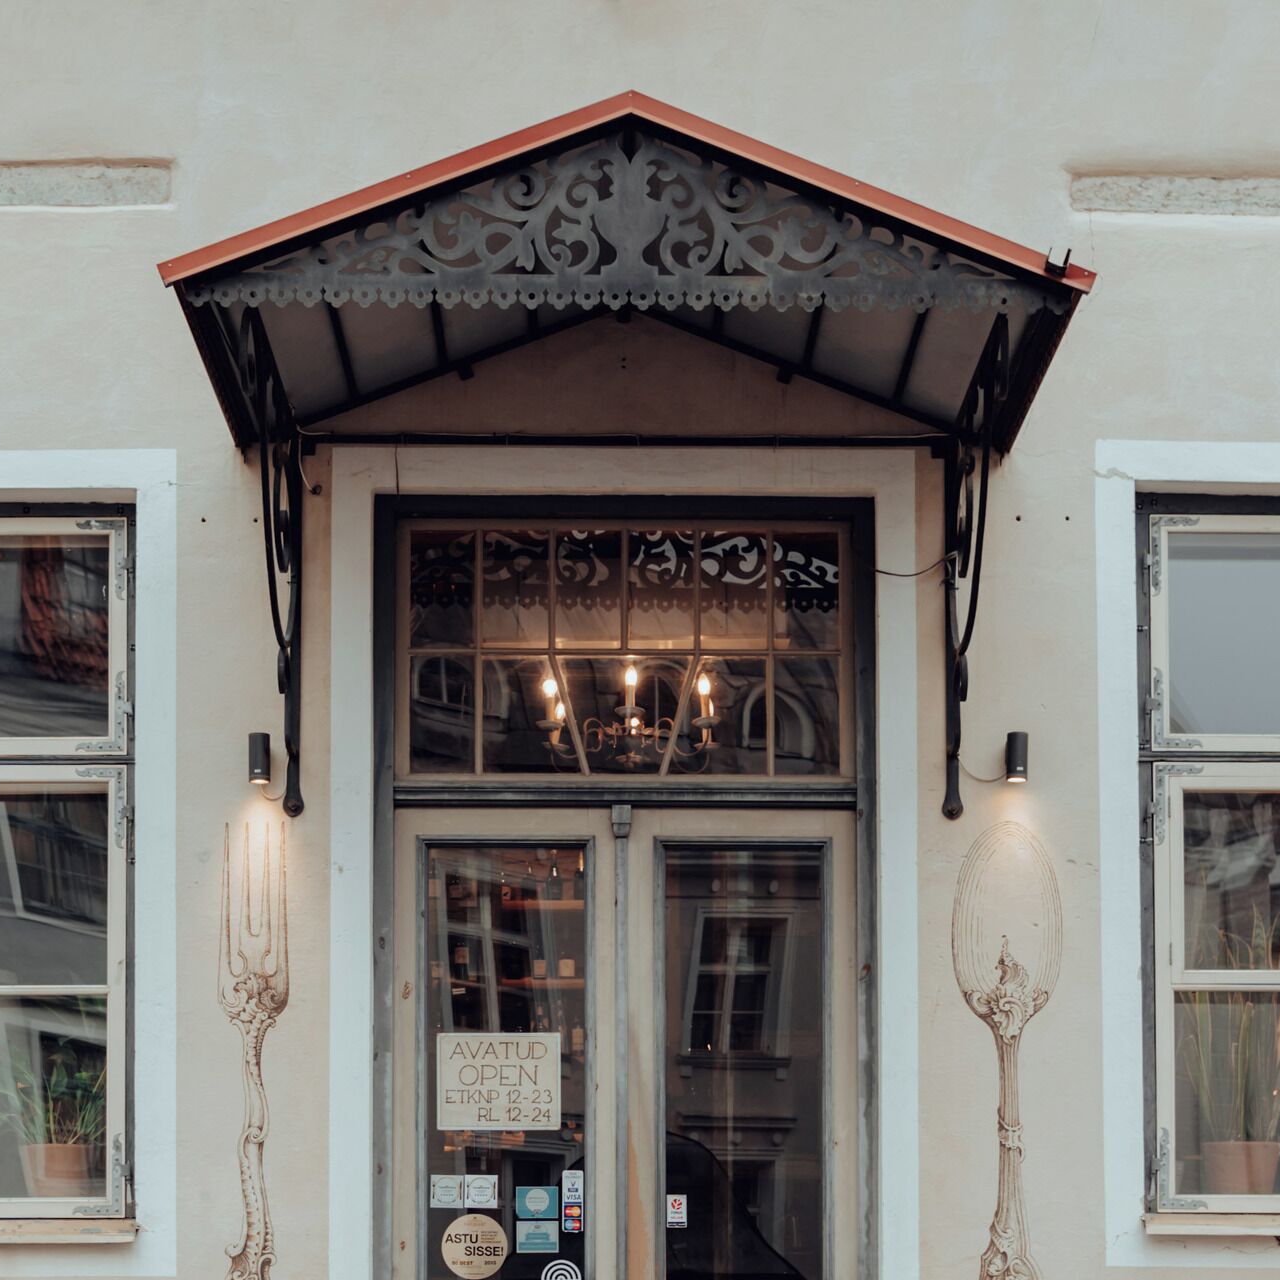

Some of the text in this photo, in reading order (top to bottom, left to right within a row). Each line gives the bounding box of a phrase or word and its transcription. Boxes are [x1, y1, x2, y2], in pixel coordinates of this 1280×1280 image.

[449, 1041, 548, 1060] AVATUD
[458, 1064, 539, 1086] OPEN
[445, 1089, 500, 1104] ETKNP
[478, 1107, 500, 1122] RL
[445, 1233, 479, 1244] ASTU
[464, 1246, 504, 1257] SISSE!
